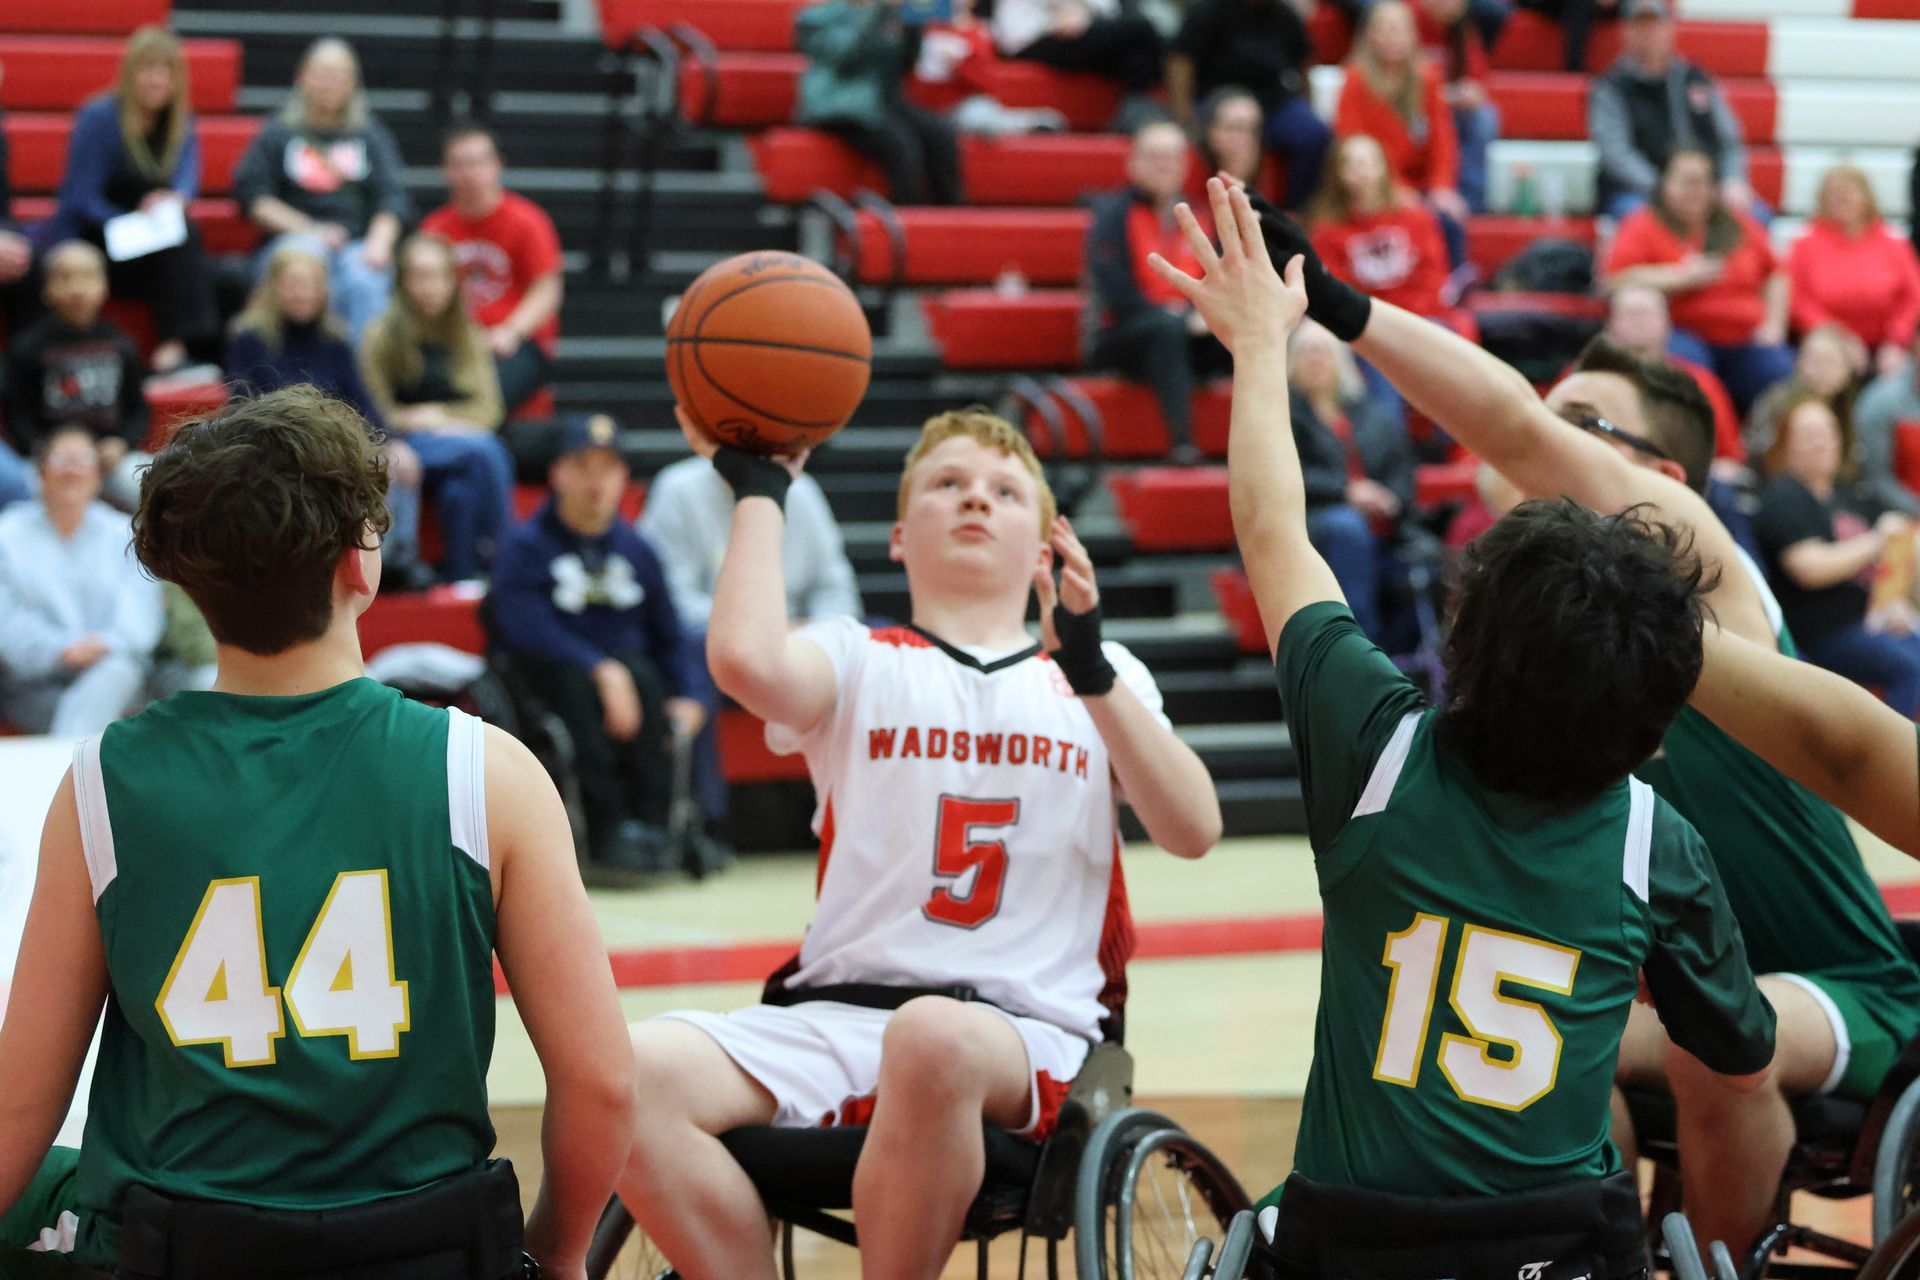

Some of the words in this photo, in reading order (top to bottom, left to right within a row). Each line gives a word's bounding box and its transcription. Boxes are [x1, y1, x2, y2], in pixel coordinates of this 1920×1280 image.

[868, 726, 1088, 779] WADSWORTH
[921, 792, 1020, 931] 5
[154, 868, 411, 1068] 44
[1372, 911, 1582, 1112] 15
